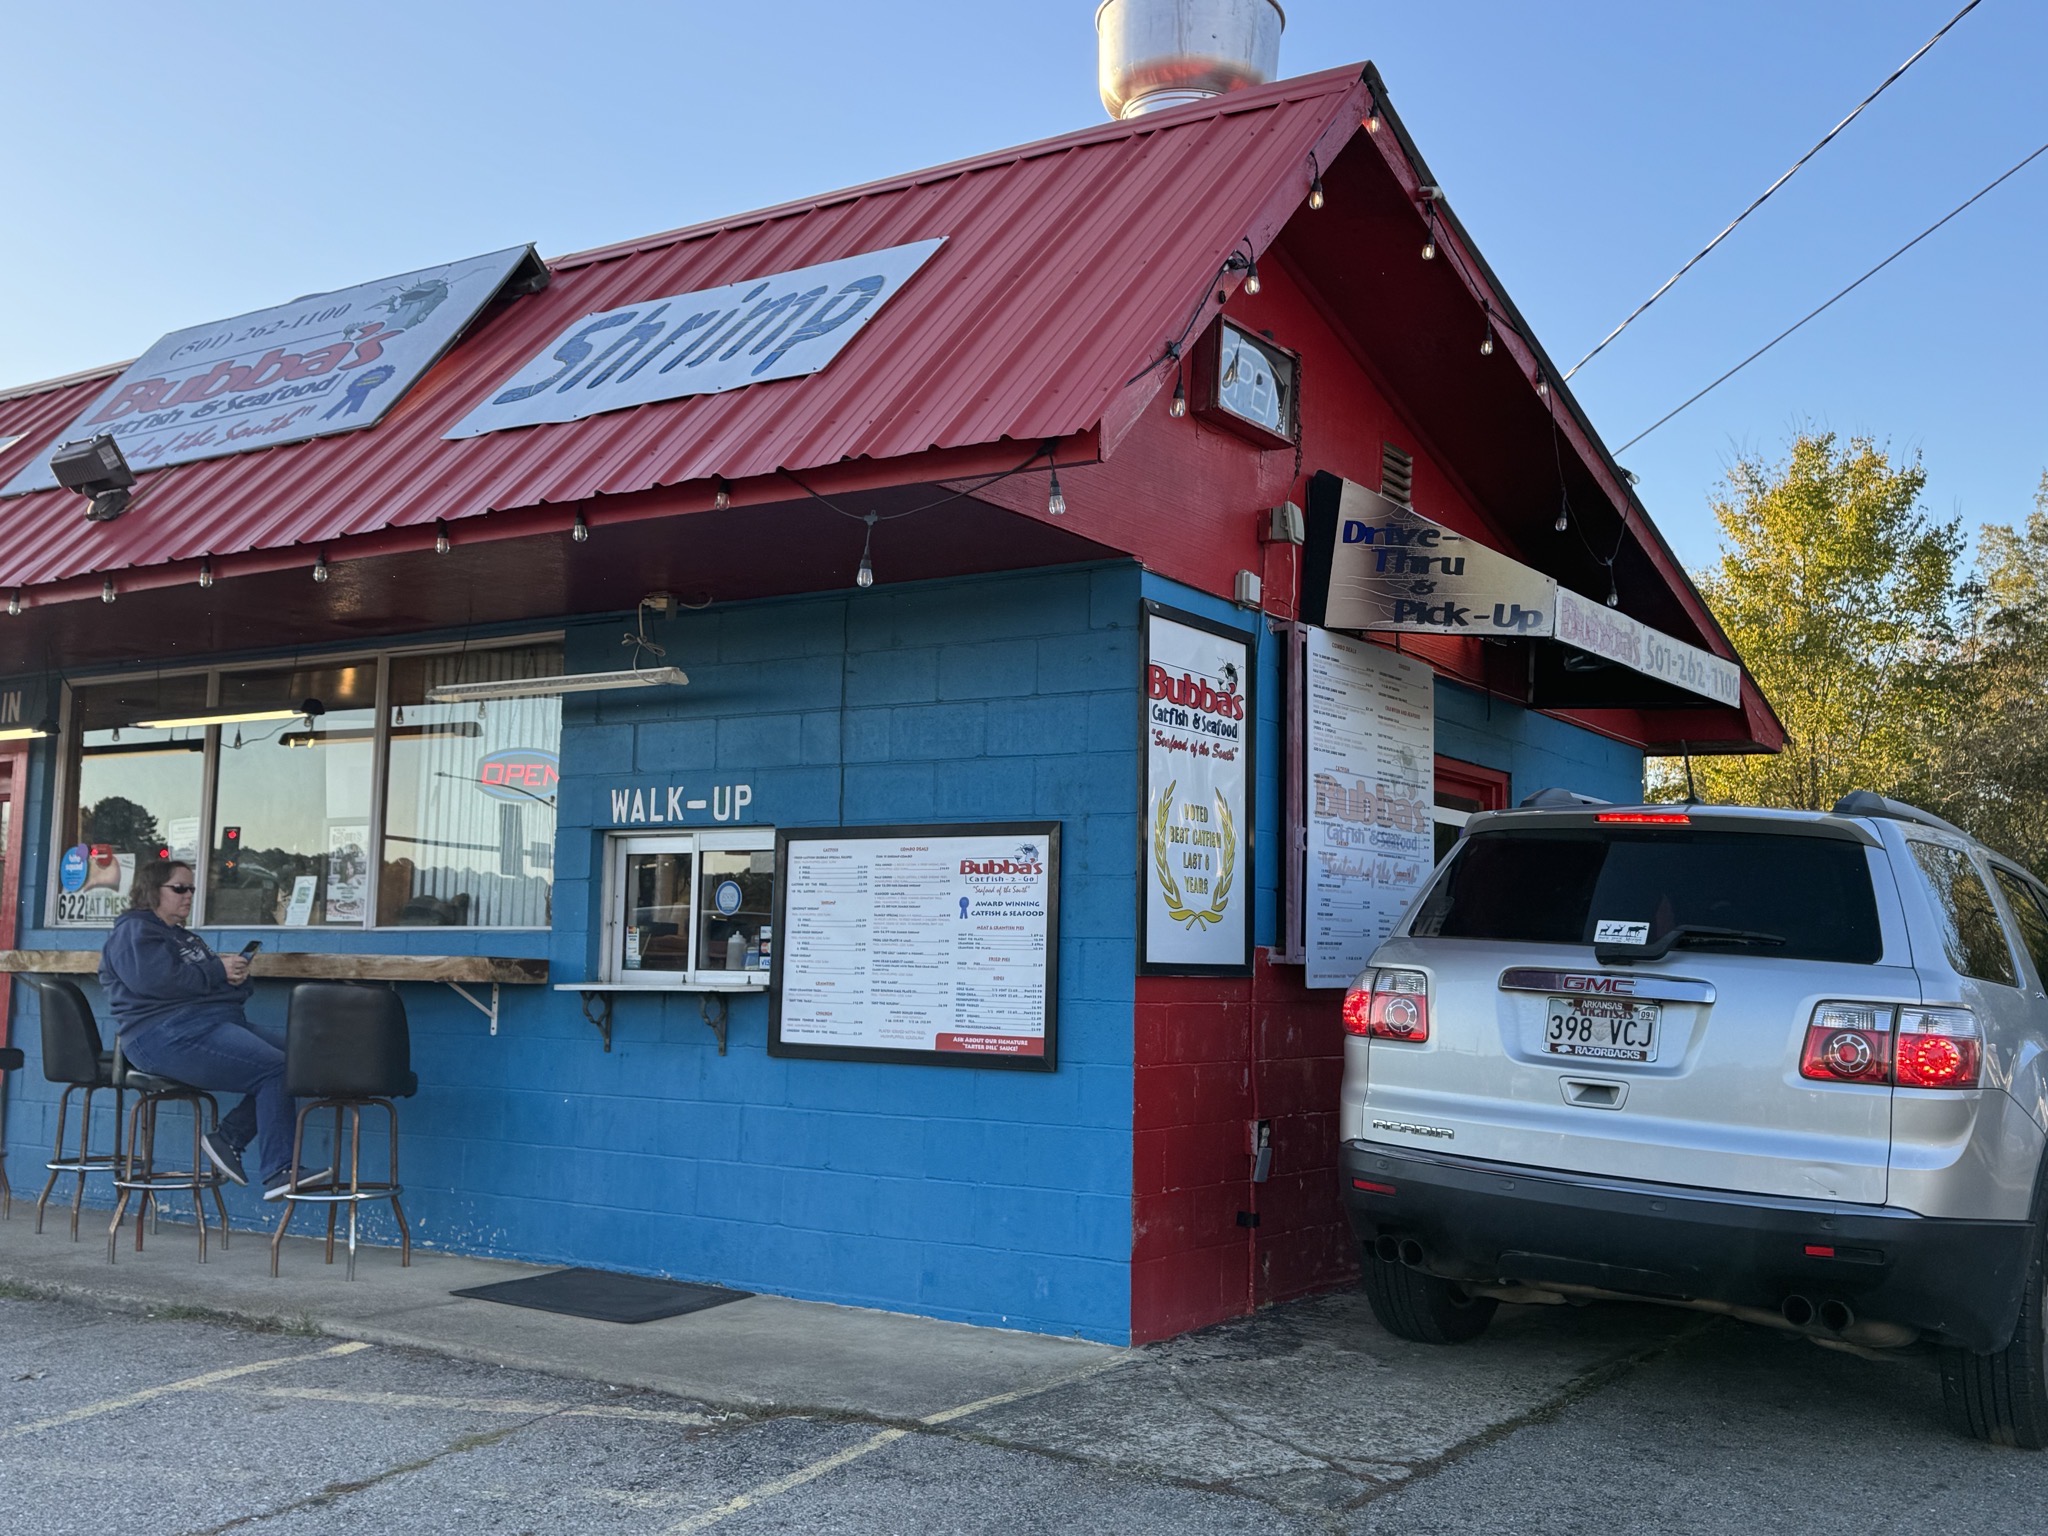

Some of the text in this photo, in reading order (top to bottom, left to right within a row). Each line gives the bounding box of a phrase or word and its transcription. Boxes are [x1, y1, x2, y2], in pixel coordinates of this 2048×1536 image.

[170, 303, 352, 361] (501) 262-1100
[493, 275, 884, 405] Shrimp
[83, 321, 405, 427] Bubba's
[218, 373, 341, 414] Seafood
[174, 425, 217, 454] the
[1342, 520, 1460, 548] Drive-
[1371, 546, 1466, 576] Thru
[1409, 579, 1438, 596] &
[1393, 599, 1545, 634] Pick-Up
[1560, 595, 1740, 701] Bubba's 501-262-1100
[1148, 664, 1245, 721] Bubba's
[1152, 703, 1238, 739] Catfish & Seafood
[1190, 740, 1198, 758] of
[1199, 741, 1210, 757] the
[611, 784, 752, 824] WALK-UP
[1184, 803, 1208, 823] VOTED
[1314, 772, 1426, 835] Bubba's
[1169, 825, 1222, 849] BEST CATFISH
[1327, 824, 1365, 845] Catfish
[959, 857, 1043, 875] Bubba's
[1183, 851, 1210, 871] LAST 8
[1376, 859, 1391, 880] the
[996, 885, 1002, 896] of
[1003, 885, 1011, 894] the
[1184, 875, 1208, 895] YEARS
[58, 894, 85, 919] 622
[1563, 975, 1636, 996] GMC
[1581, 1000, 1624, 1010] ARKANSAS
[998, 1038, 1029, 1046] SIGNATURE
[1550, 1014, 1653, 1048] 398 VCJ
[1574, 1046, 1641, 1060] RAZORBACKS
[1372, 1118, 1455, 1139] ACADIA
